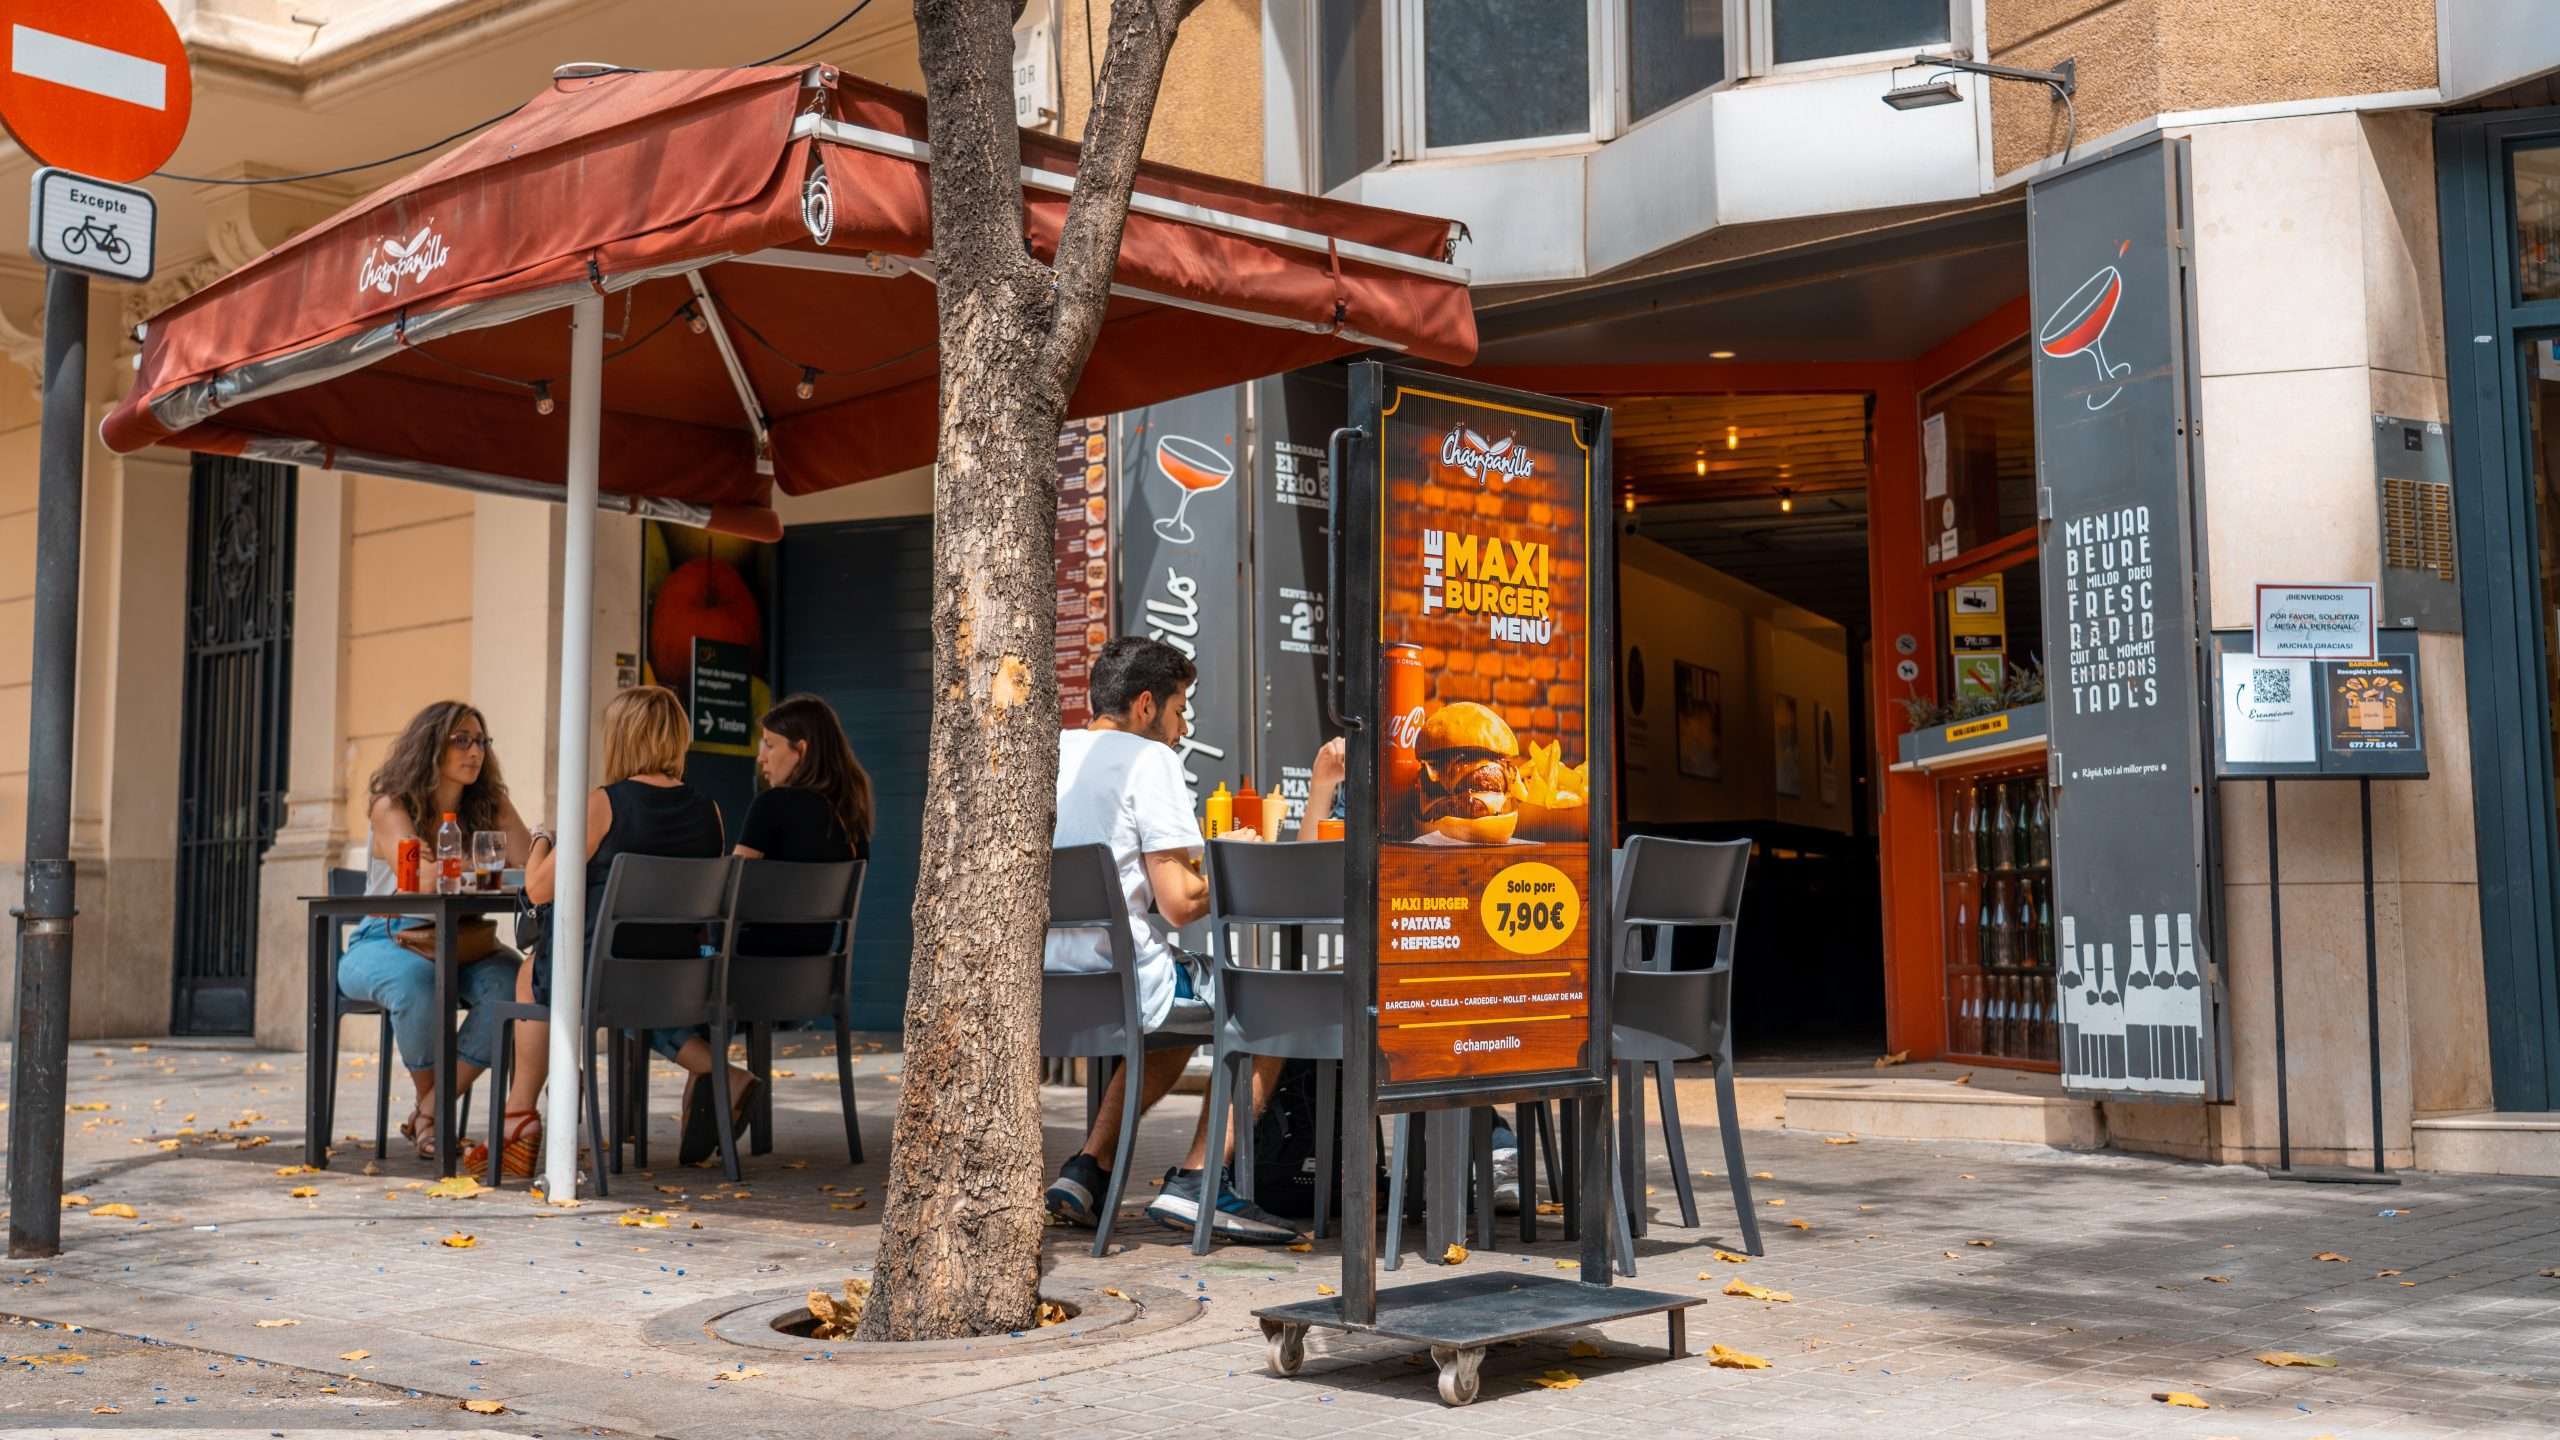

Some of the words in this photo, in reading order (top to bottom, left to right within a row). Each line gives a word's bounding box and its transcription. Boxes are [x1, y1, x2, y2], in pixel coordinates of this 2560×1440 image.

[70, 188, 127, 214] Excepte
[359, 233, 451, 297] Champanillo
[1275, 453, 1299, 474] EN
[1441, 429, 1534, 484] Champanillo
[2065, 505, 2150, 548] MENJAR
[1445, 531, 1549, 589] MAXI
[2066, 536, 2152, 577] BEURE
[1424, 529, 1443, 615] THE
[2067, 577, 2079, 592] AL
[2086, 569, 2120, 589] MILLOR
[2128, 565, 2152, 582] PREU
[1445, 579, 1550, 619] BURGER
[2068, 581, 2153, 622] FRESC
[2286, 593, 2344, 602] ¡BIENVENIDOS!
[1490, 614, 1551, 645] MENÚ
[2288, 613, 2317, 621] FAVOR,
[2070, 612, 2154, 650] RÀPID
[2070, 648, 2090, 665] CUIT
[2098, 645, 2109, 662] AL
[2117, 641, 2155, 658] MOMENT
[2071, 657, 2156, 685] ENTREPANS
[2103, 766, 2113, 777] bo
[2123, 764, 2142, 775] millor
[2143, 764, 2159, 775] preu
[1507, 880, 1531, 893] Solo
[1534, 881, 1555, 895] por:
[1391, 897, 1420, 911] MAXI
[1423, 897, 1469, 911] BURGER
[1401, 916, 1451, 931] PATATAS
[1496, 902, 1565, 937] 7,90€
[1401, 936, 1461, 950] REFRESCO
[1385, 999, 1425, 1010] BARCELONA
[1430, 998, 1459, 1008] CALELLA
[1464, 996, 1498, 1006] CARDEDEU
[1503, 994, 1526, 1004] MOLLET
[1532, 993, 1560, 1003] MALGRAT
[1560, 992, 1570, 1001] DE
[1570, 991, 1583, 1001] MAR
[1453, 1035, 1521, 1055] @champanillo
